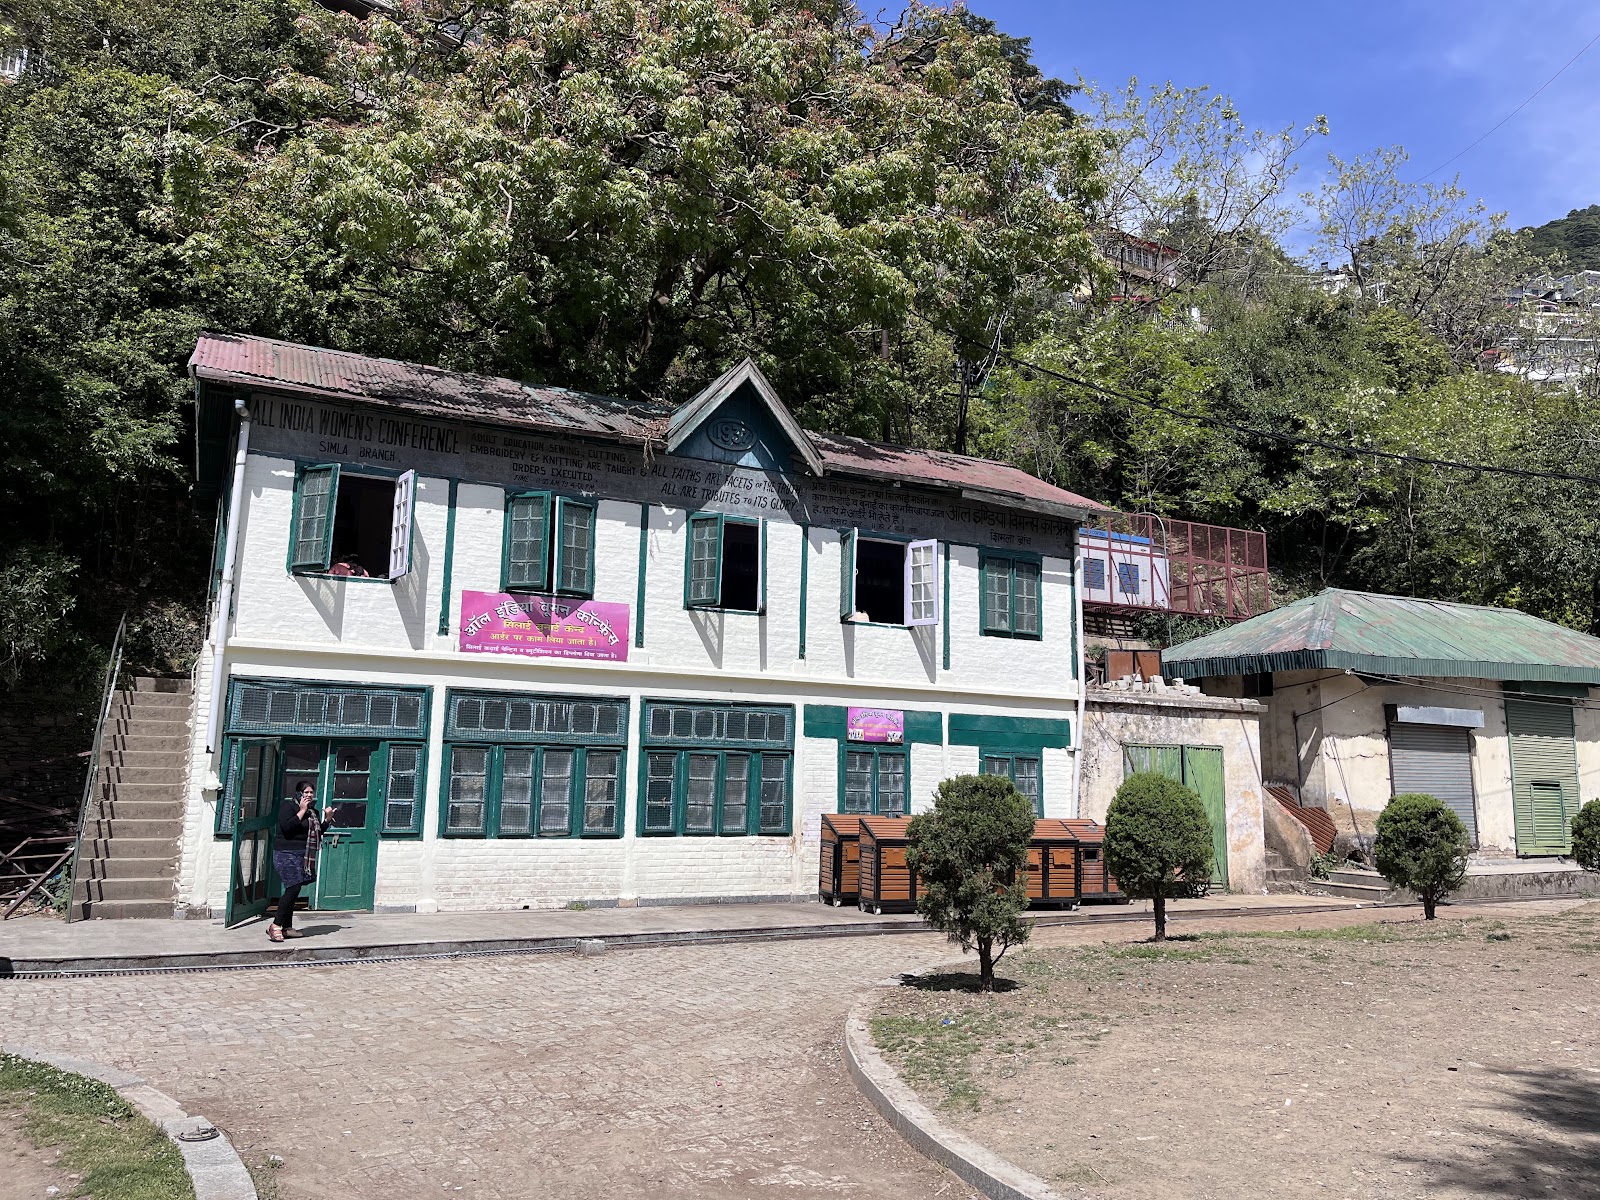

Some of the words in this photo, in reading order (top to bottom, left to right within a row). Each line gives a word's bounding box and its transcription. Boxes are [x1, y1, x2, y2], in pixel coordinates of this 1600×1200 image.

[250, 399, 275, 427] ALL
[278, 402, 314, 434] INDIA
[378, 418, 460, 455] CONFERENCE
[712, 423, 752, 445] 1937
[318, 440, 349, 456] SIMLA
[470, 432, 499, 445] ADULT
[503, 436, 545, 452] EDUCATION
[470, 444, 526, 461] EMBROIDERY
[530, 452, 540, 463] &
[542, 455, 584, 469] KNITTING
[586, 461, 602, 471] ARE
[606, 463, 637, 476] TAUGHT
[512, 462, 547, 476] ORDERS
[651, 464, 668, 478] ALL
[671, 467, 702, 483] FAITHS
[704, 472, 722, 486] ARE
[724, 474, 754, 490] FACETS
[660, 482, 677, 496] ALL
[680, 485, 698, 499] ARE
[700, 488, 741, 505] TRIBUTES
[743, 496, 752, 505] TO
[753, 495, 768, 508] ITS
[867, 489, 884, 500] तथा
[885, 489, 910, 504] सिलाई
[878, 502, 888, 512] का
[946, 504, 971, 523] आल
[973, 504, 1006, 529] इण्डिया
[989, 529, 1016, 544] शिमला
[464, 612, 492, 637] ऑल
[493, 600, 534, 619] इंडिया
[503, 619, 532, 631] सिलाई
[526, 635, 543, 643] काम
[546, 634, 563, 644] लिया
[567, 638, 585, 646] जाता
